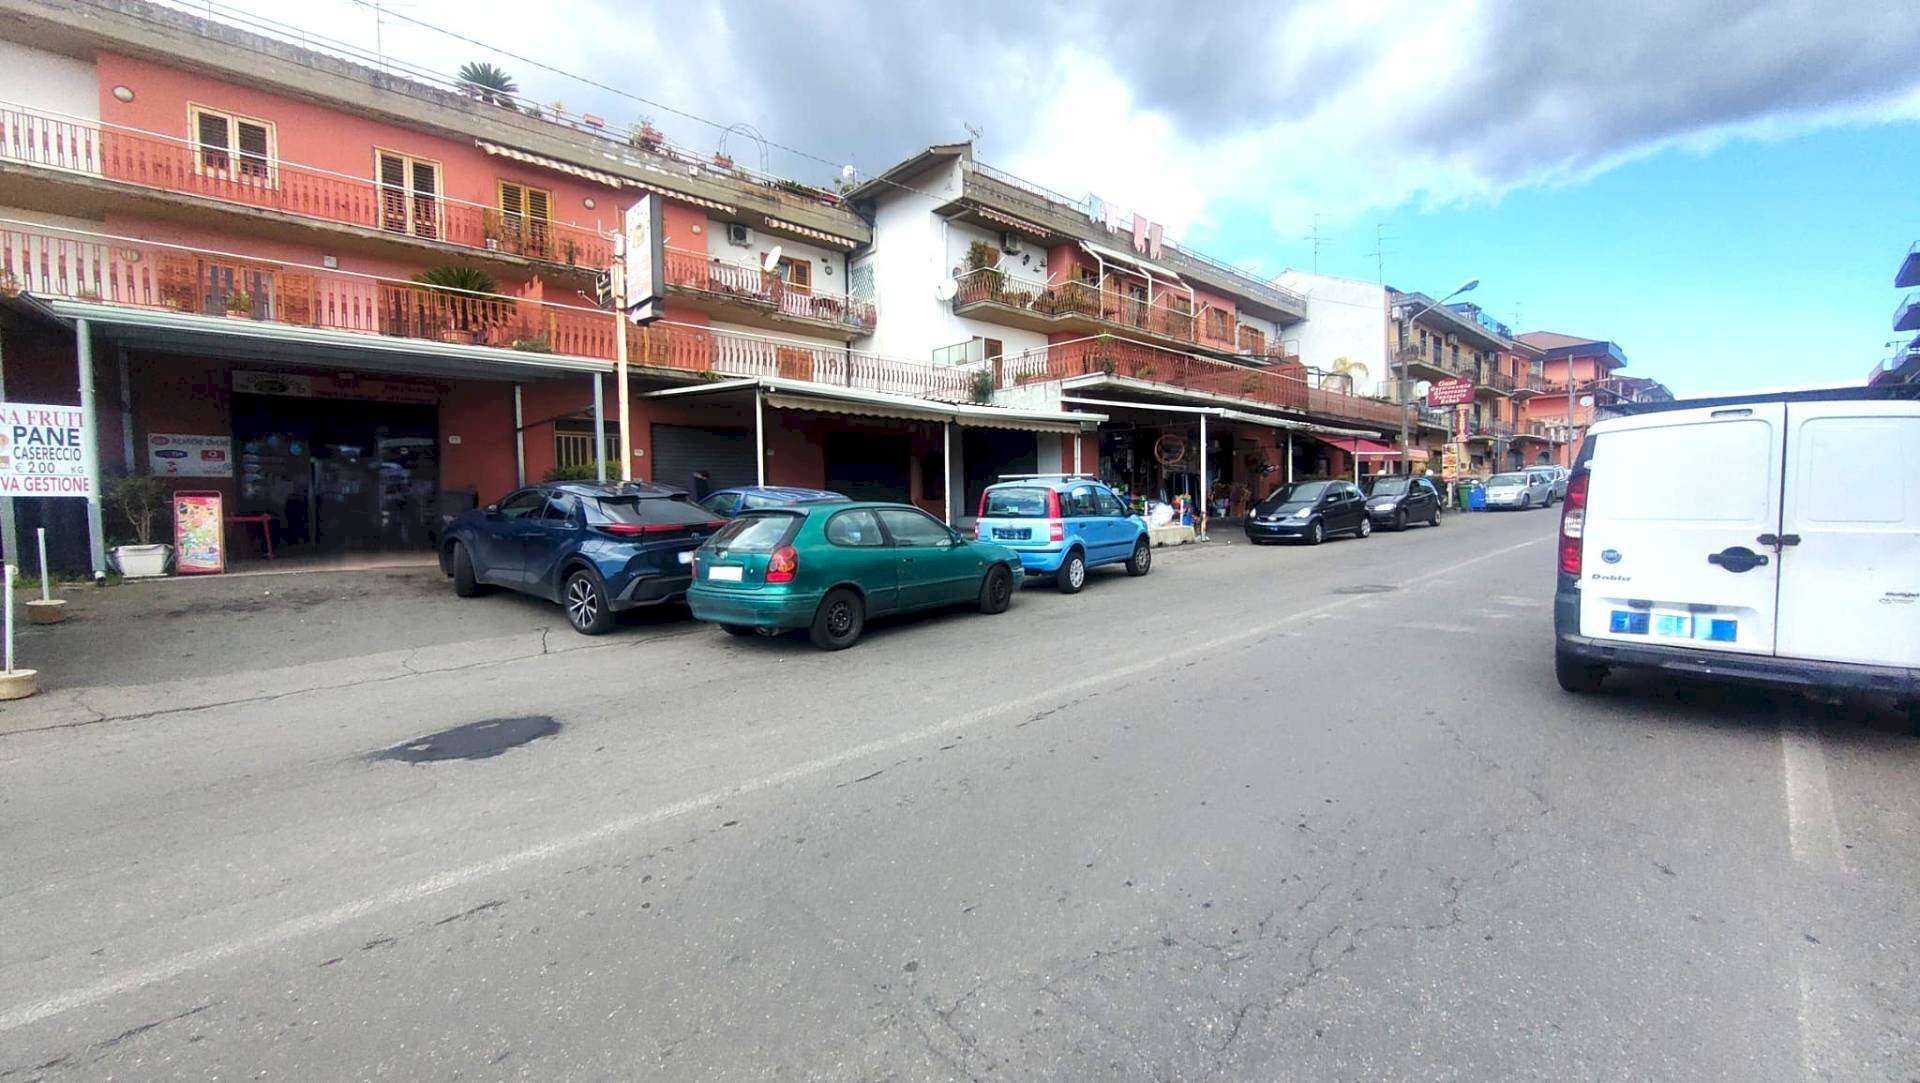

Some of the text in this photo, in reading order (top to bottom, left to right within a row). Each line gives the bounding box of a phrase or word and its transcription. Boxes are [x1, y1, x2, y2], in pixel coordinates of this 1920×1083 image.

[13, 426, 80, 446] PANE
[13, 446, 81, 461] CASERECCIO
[24, 477, 89, 492] GESTIONE
